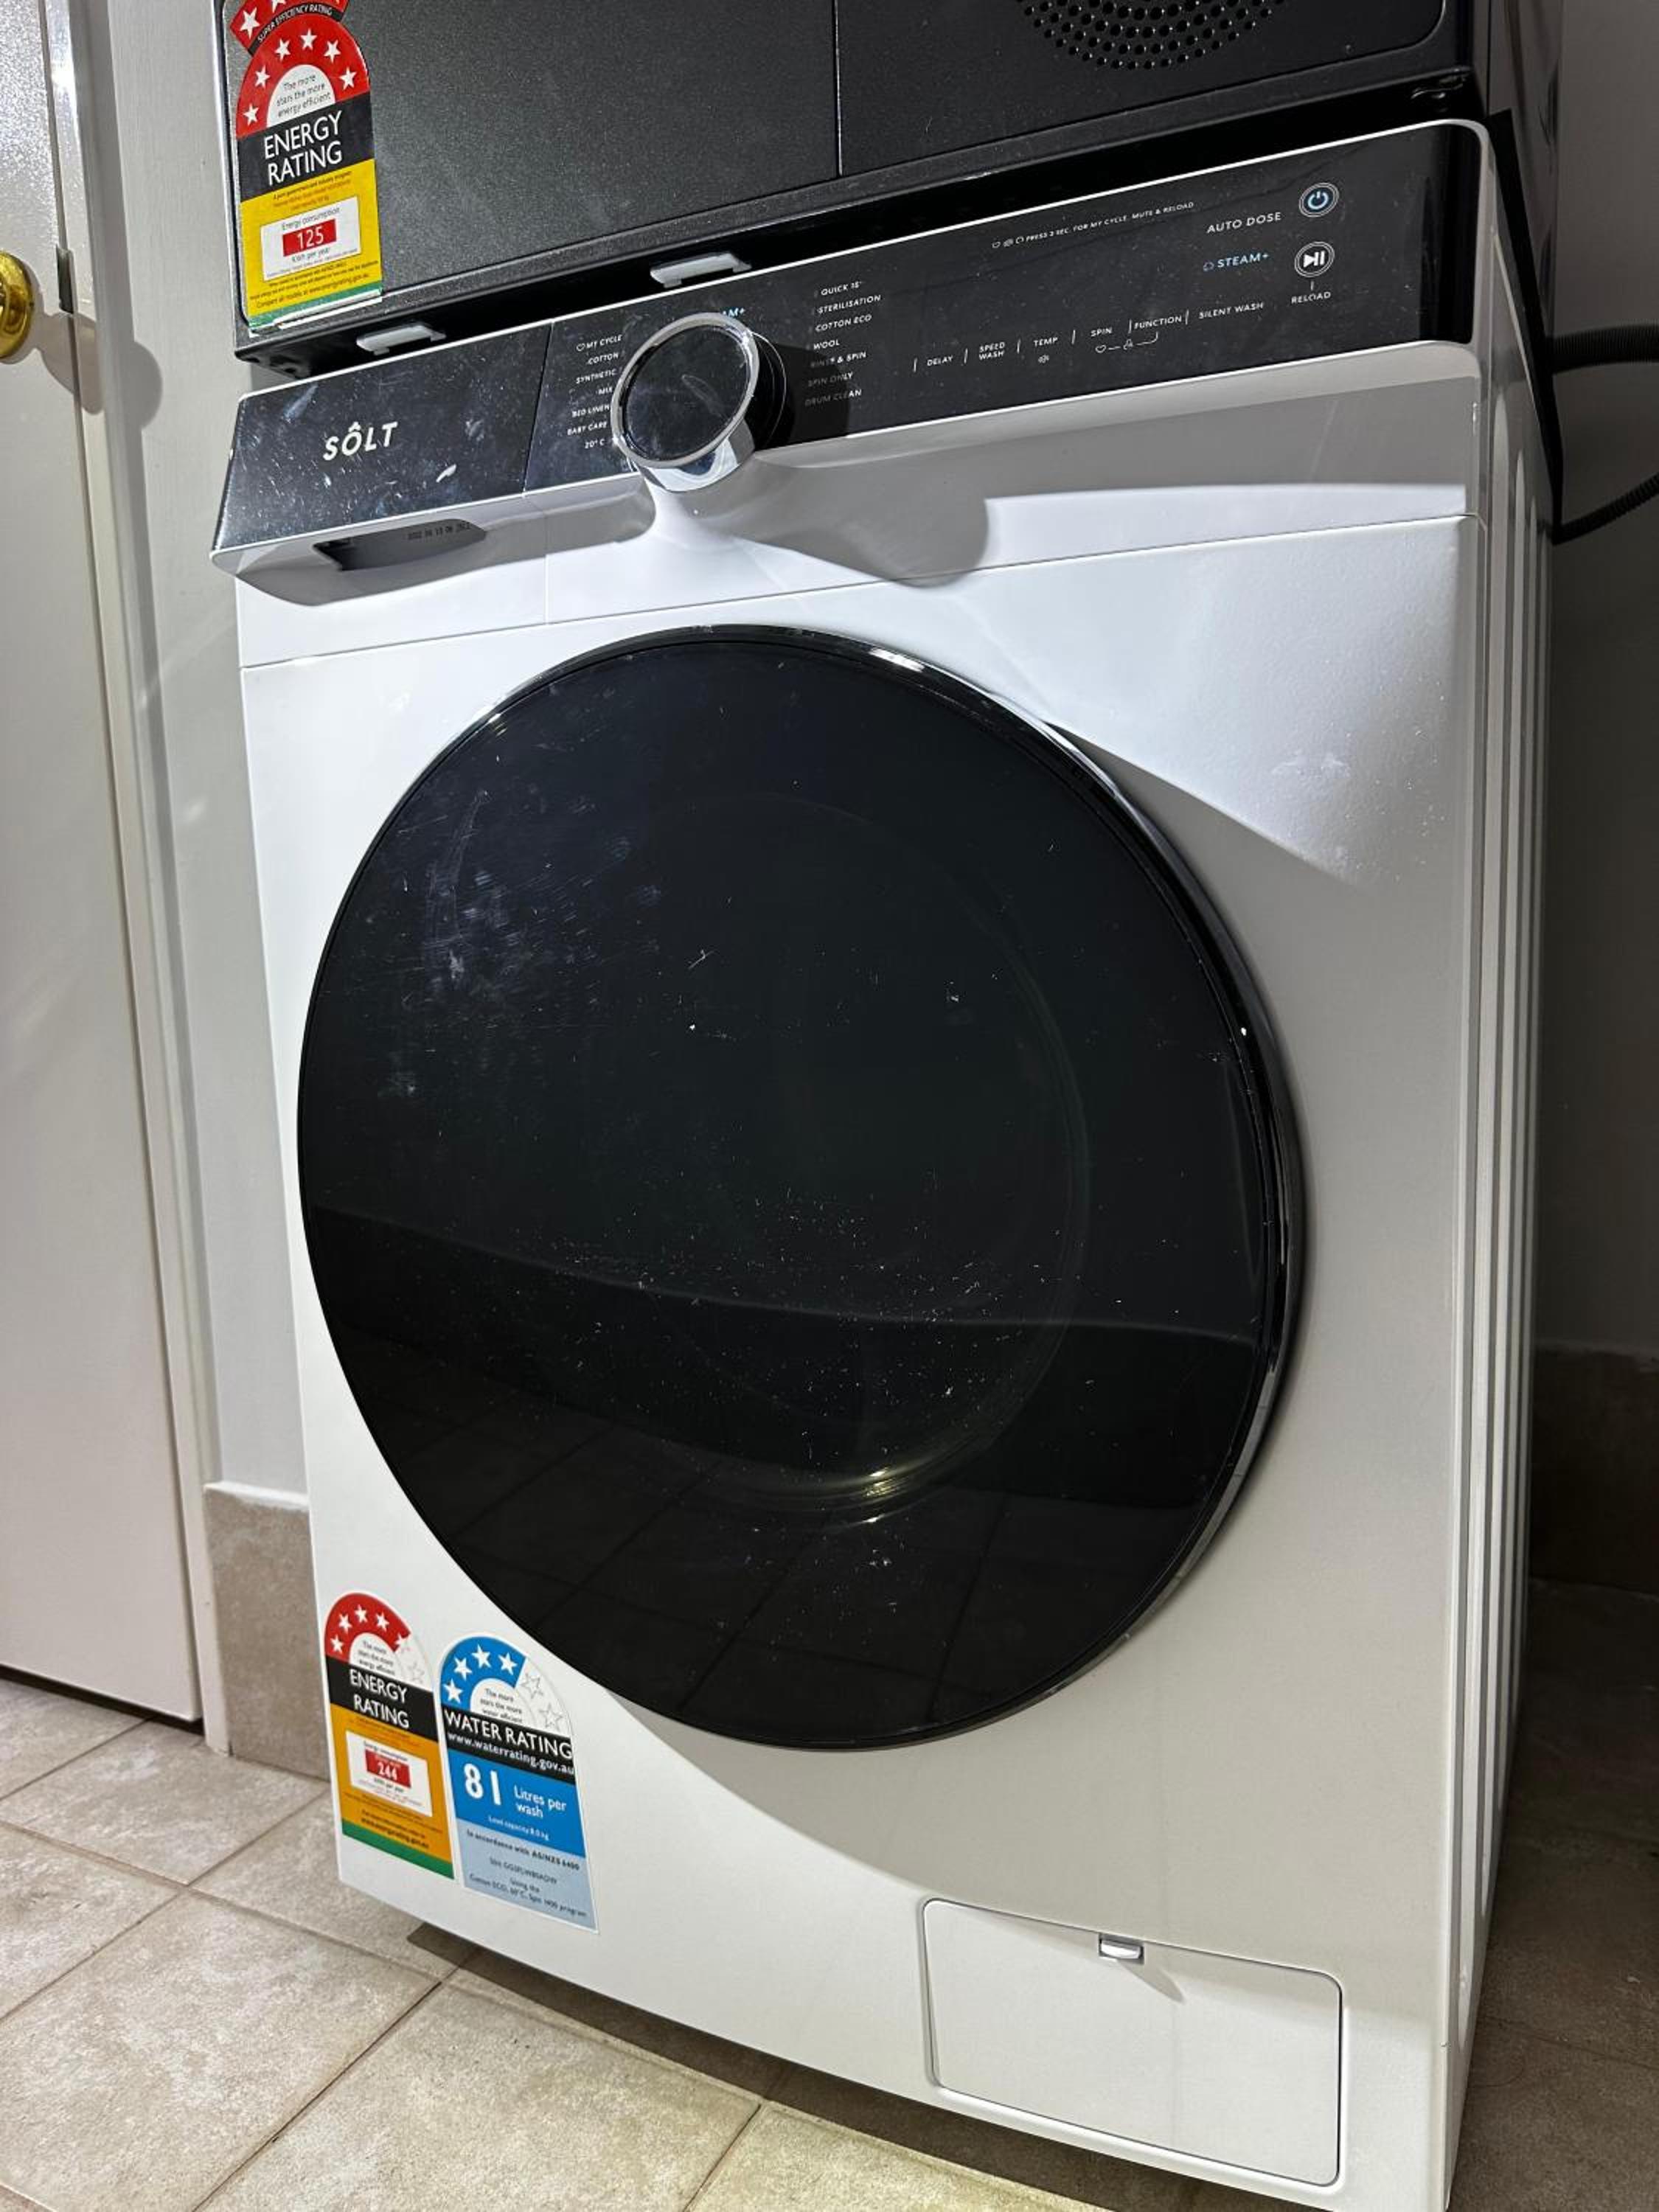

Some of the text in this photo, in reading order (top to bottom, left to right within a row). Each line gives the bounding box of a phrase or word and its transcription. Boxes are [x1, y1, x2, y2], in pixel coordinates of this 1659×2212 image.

[264, 110, 342, 159] ENERGY
[268, 141, 342, 186] RATING
[1073, 223, 1088, 232] FOR
[1132, 209, 1152, 219] MUTE
[1163, 201, 1194, 212] RELOAD
[1206, 212, 1281, 234] AUTO DOSE
[296, 226, 324, 249] 125
[1217, 252, 1269, 268] STEAM+
[821, 284, 849, 296] QUICK
[1291, 291, 1331, 304] RELOAD
[817, 294, 881, 314] STERILISATION
[1198, 302, 1264, 319] SILENT WASH
[815, 313, 872, 333] COTTON ECO
[1134, 316, 1182, 330] FUNCTION
[1091, 327, 1113, 337] SPIN
[586, 334, 622, 349] MY CYCLE
[813, 339, 840, 349] WOOL
[979, 341, 1005, 353] SPEED
[1034, 336, 1058, 347] TEMP
[588, 352, 619, 364] COTTON
[837, 355, 844, 364] &
[846, 352, 866, 362] SPIN
[927, 355, 953, 366] DELAY
[978, 350, 1005, 361] WASH
[575, 368, 617, 384] SYNTHETIC
[830, 372, 853, 383] ONLY
[567, 421, 608, 436] BABY CARE
[322, 421, 398, 461] SÔLT
[349, 1669, 407, 1703] ENERGY
[485, 1688, 514, 1702] The more
[354, 1694, 409, 1729] RATING
[443, 1708, 502, 1741] WATER
[505, 1727, 573, 1759] RATING
[448, 1733, 574, 1775] www.waterrating.gov.au
[378, 1761, 397, 1781] 244
[514, 1784, 567, 1812] Litres per
[515, 1802, 543, 1819] wash
